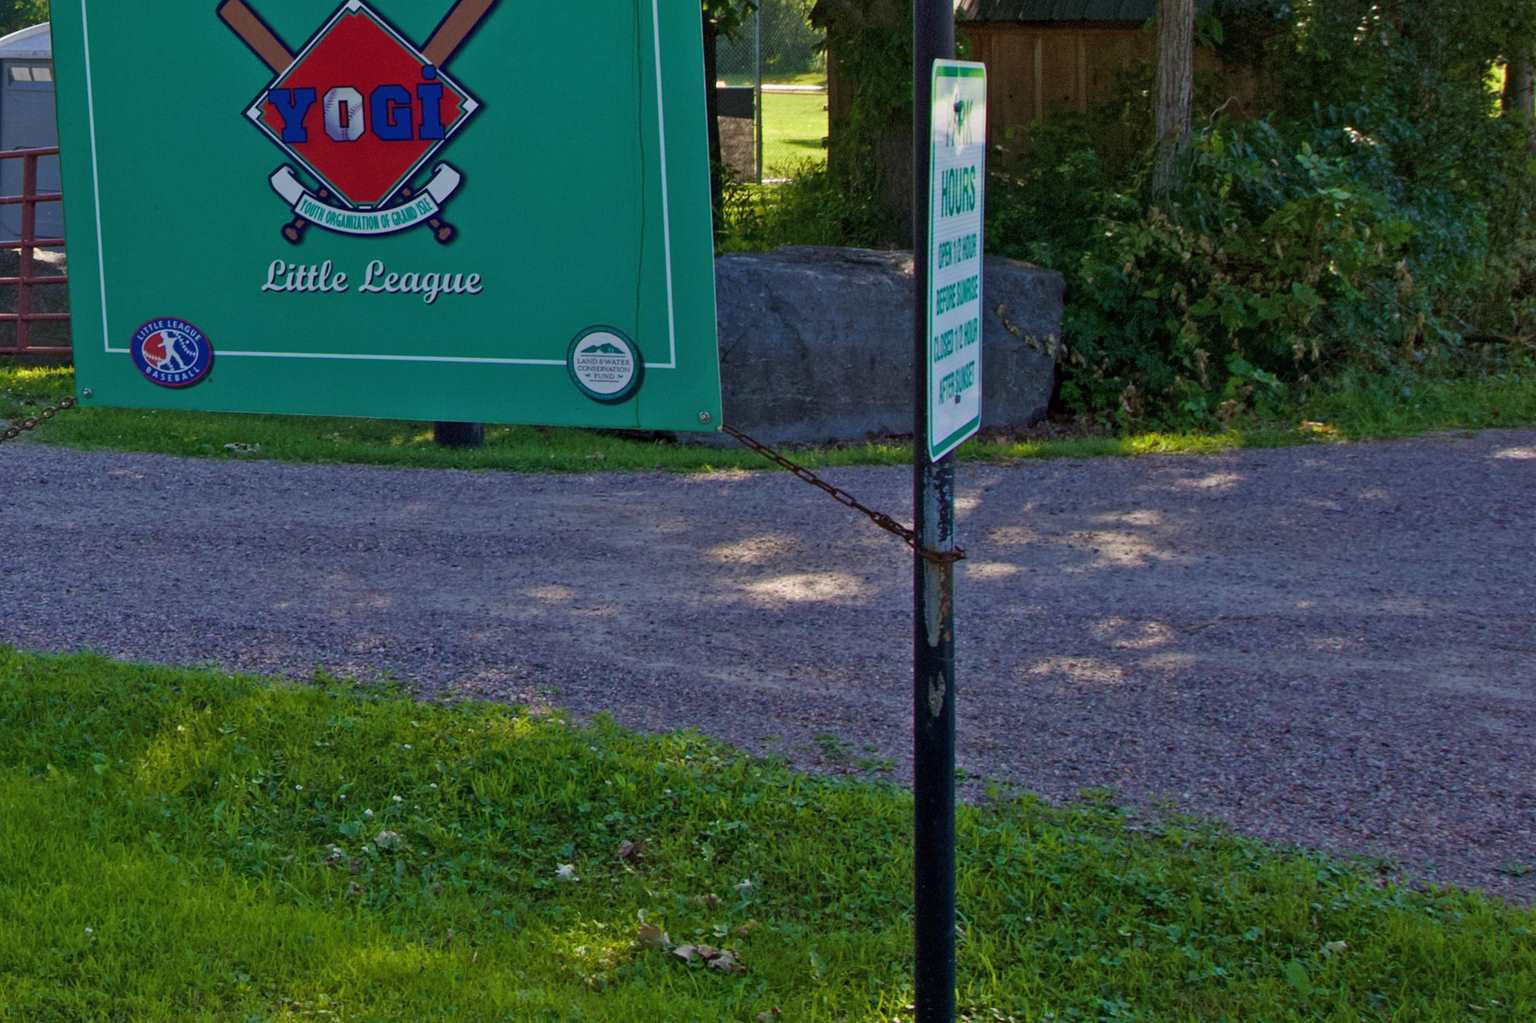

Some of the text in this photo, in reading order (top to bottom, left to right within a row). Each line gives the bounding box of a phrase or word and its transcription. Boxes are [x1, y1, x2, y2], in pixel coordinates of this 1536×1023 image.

[940, 165, 976, 217] HOURS
[299, 198, 324, 220] YOUTH
[324, 210, 380, 230] ORGANIZATION
[380, 214, 391, 229] OF
[417, 197, 433, 216] ISLE
[262, 259, 483, 304] Little League
[137, 320, 201, 341] LITTLE LEAGUE
[145, 366, 200, 382] BASEBALL
